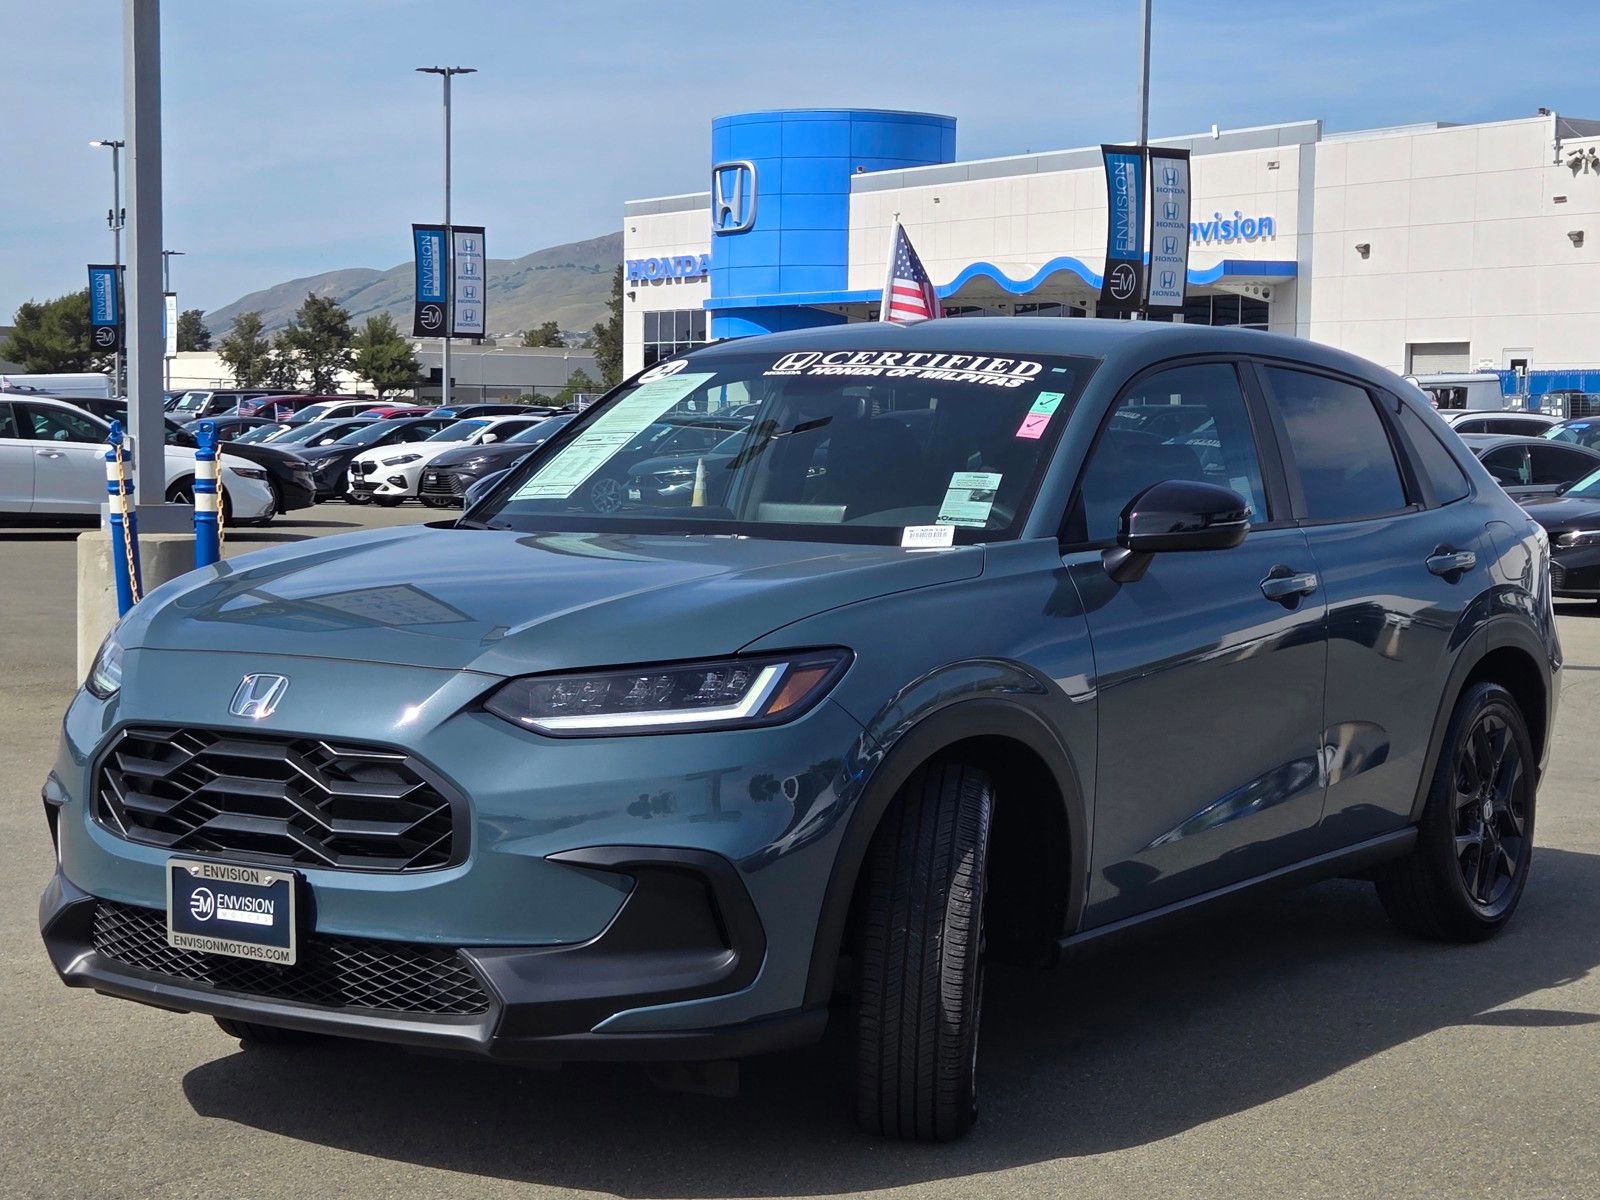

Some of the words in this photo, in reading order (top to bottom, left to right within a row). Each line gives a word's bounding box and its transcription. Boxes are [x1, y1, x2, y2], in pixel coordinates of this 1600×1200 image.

[1114, 162, 1128, 251] ENVISION
[1156, 221, 1186, 229] HONDA
[1190, 210, 1273, 241] nvision
[421, 235, 433, 296] ENVISION
[626, 253, 711, 281] HONDA
[95, 273, 106, 320] ENVISION
[822, 351, 1043, 376] CERTIFIED
[807, 367, 885, 376] HONDA
[885, 368, 921, 377] OF
[917, 370, 1026, 388] MILPITAS
[203, 864, 260, 883] ENVISION
[217, 893, 274, 914] ENVISION
[173, 935, 290, 961] ENVISIONMOTORS.COM
